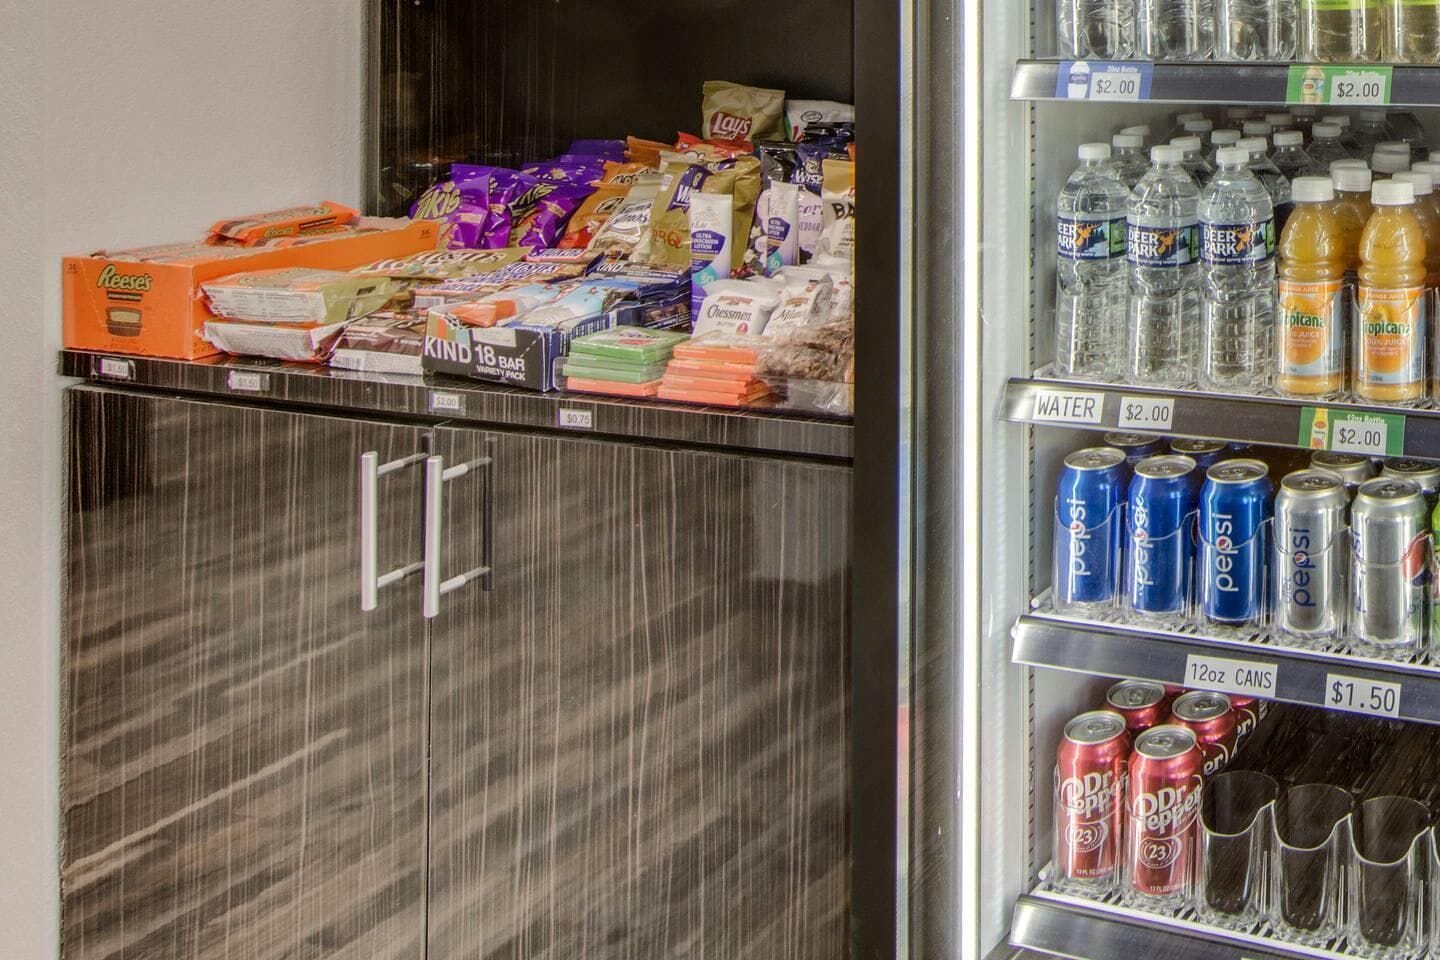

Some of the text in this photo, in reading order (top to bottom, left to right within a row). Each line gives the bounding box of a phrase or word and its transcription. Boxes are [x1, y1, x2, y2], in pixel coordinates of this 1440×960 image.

[1096, 79, 1135, 95] $2.00
[1337, 82, 1379, 98] $2.00
[712, 113, 751, 140] Lay's
[1129, 230, 1159, 244] DEER
[1204, 230, 1237, 243] DEER
[1128, 242, 1160, 258] PARK
[1204, 241, 1238, 256] PARK
[97, 264, 153, 291] Reese's
[707, 304, 752, 321] Chessmen
[424, 335, 526, 372] KIND 18 BAR
[476, 364, 526, 381] VARIETY PACK
[1037, 395, 1096, 418] WATER
[1125, 404, 1169, 422] $2.00
[567, 413, 590, 424] $0.75
[1338, 429, 1381, 447] $2.00
[1067, 497, 1090, 576] pepsi
[1212, 511, 1239, 592] pepsi
[1289, 527, 1316, 608] pepsi
[1191, 663, 1272, 689] 12oz CANS
[1331, 680, 1396, 712] $1.50
[1083, 770, 1113, 791] Dr
[1157, 785, 1187, 811] Dr
[1132, 783, 1201, 835] Pepper
[1075, 828, 1093, 845] 23
[1148, 844, 1166, 861] 23
